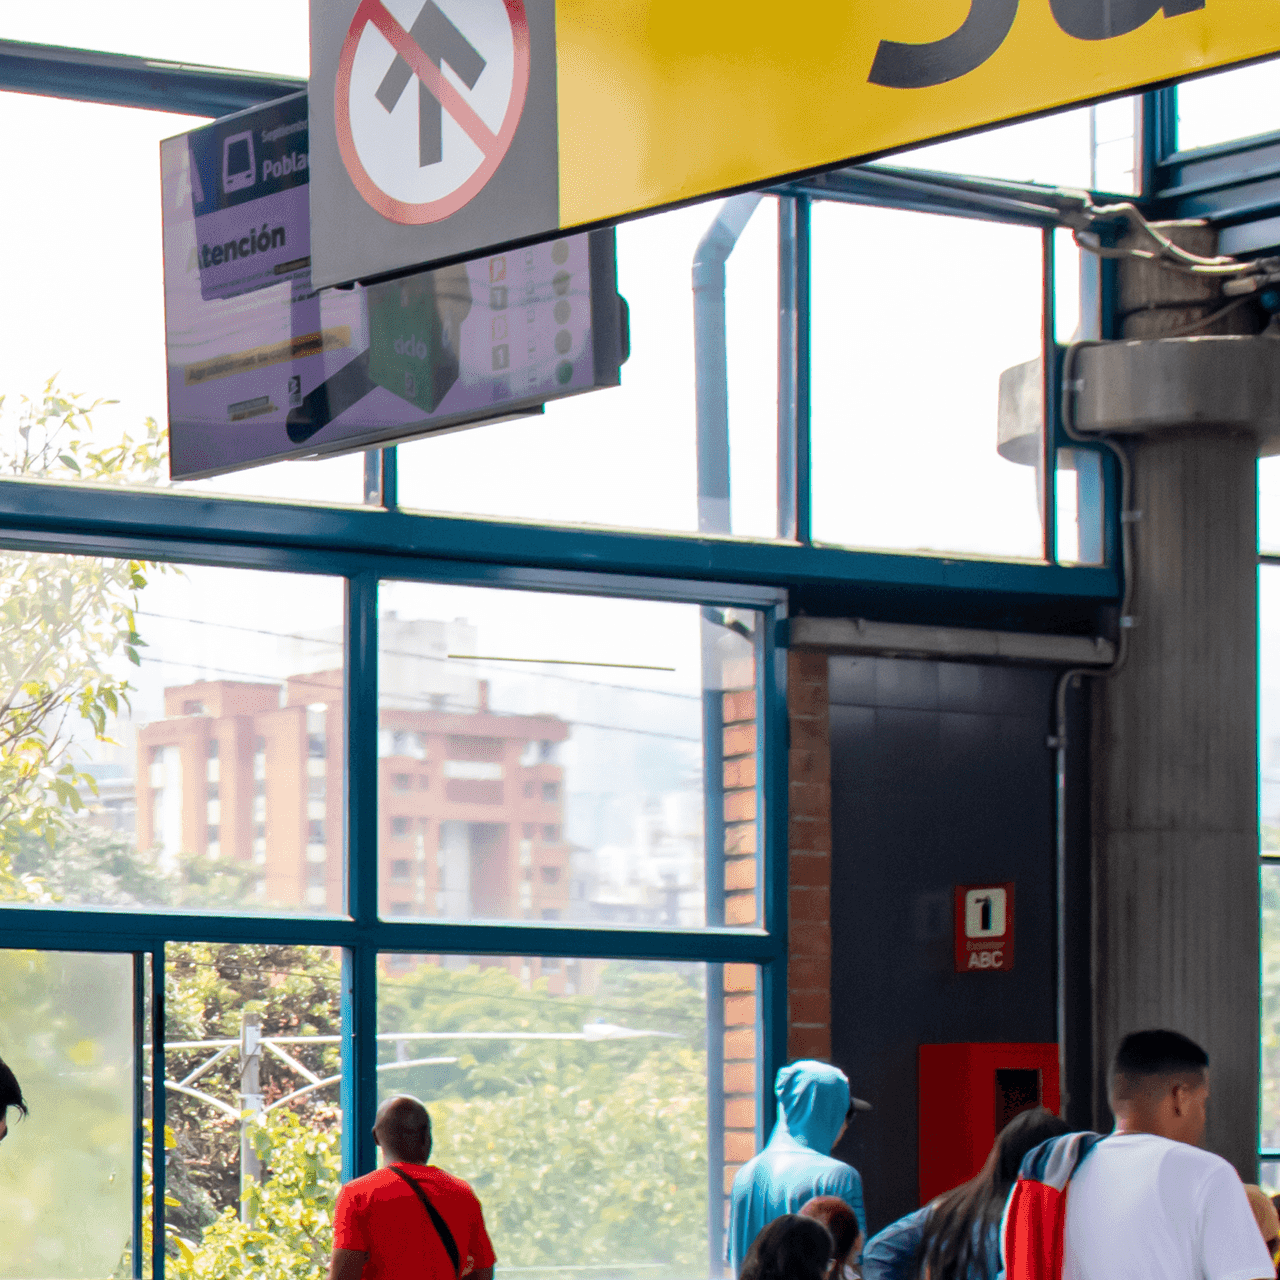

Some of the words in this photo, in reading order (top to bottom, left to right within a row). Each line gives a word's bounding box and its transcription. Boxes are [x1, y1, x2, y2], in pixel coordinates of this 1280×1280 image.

[262, 152, 309, 181] Pobla
[975, 896, 991, 930] 1
[967, 951, 1003, 969] ABC
